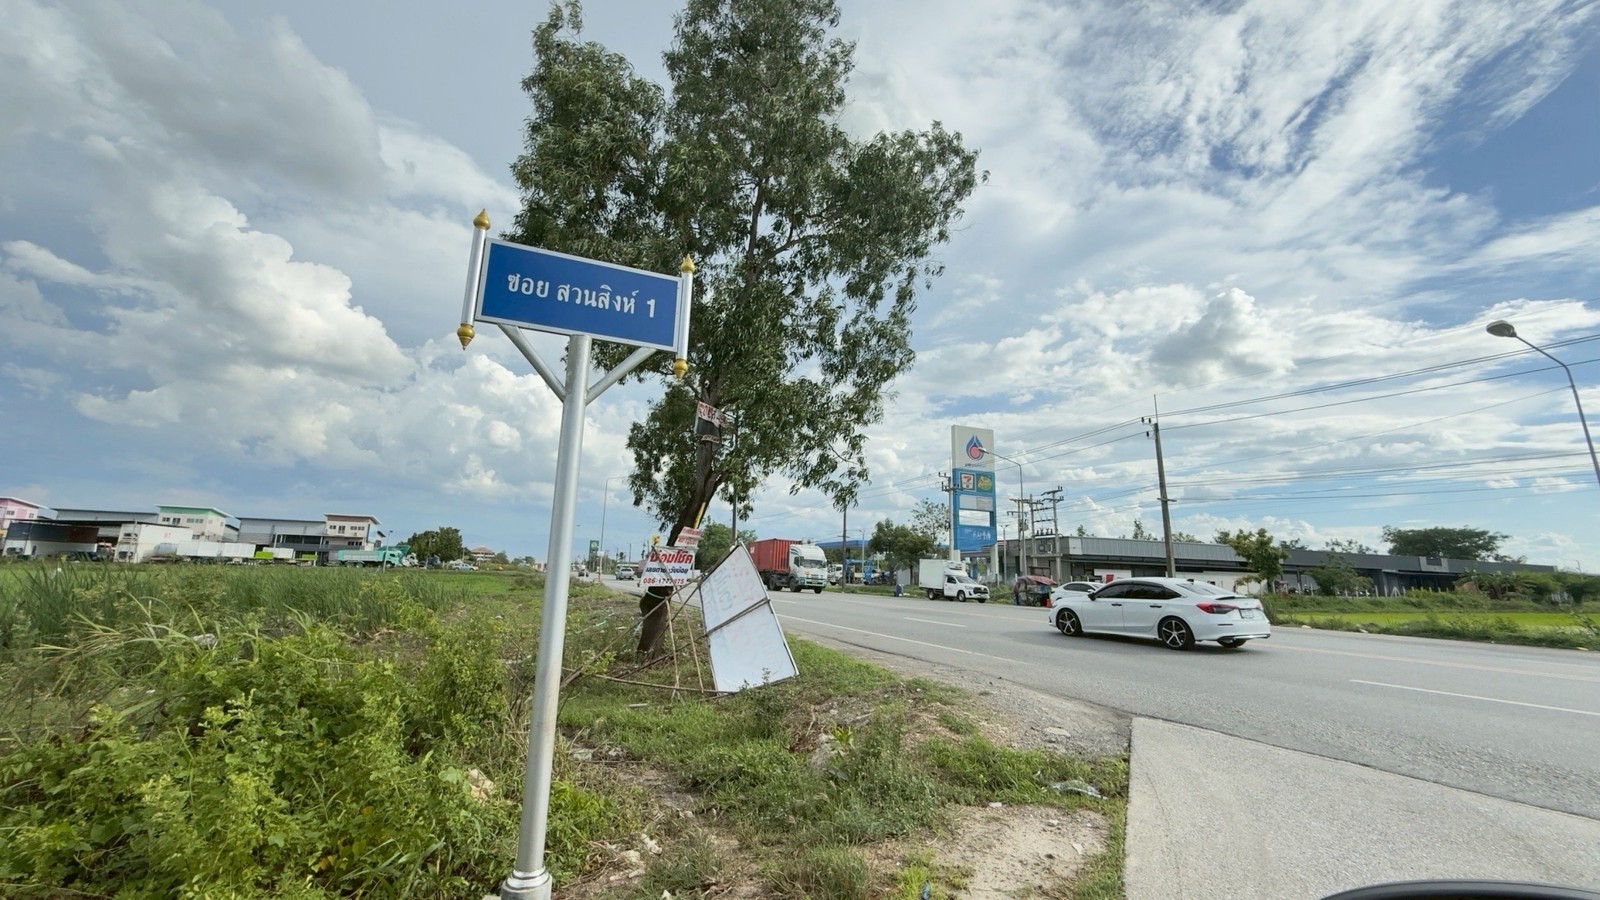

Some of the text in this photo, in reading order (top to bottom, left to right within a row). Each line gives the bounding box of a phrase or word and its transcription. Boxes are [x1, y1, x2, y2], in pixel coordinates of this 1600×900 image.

[507, 273, 656, 318] ซอย สวนสิงห์ 1
